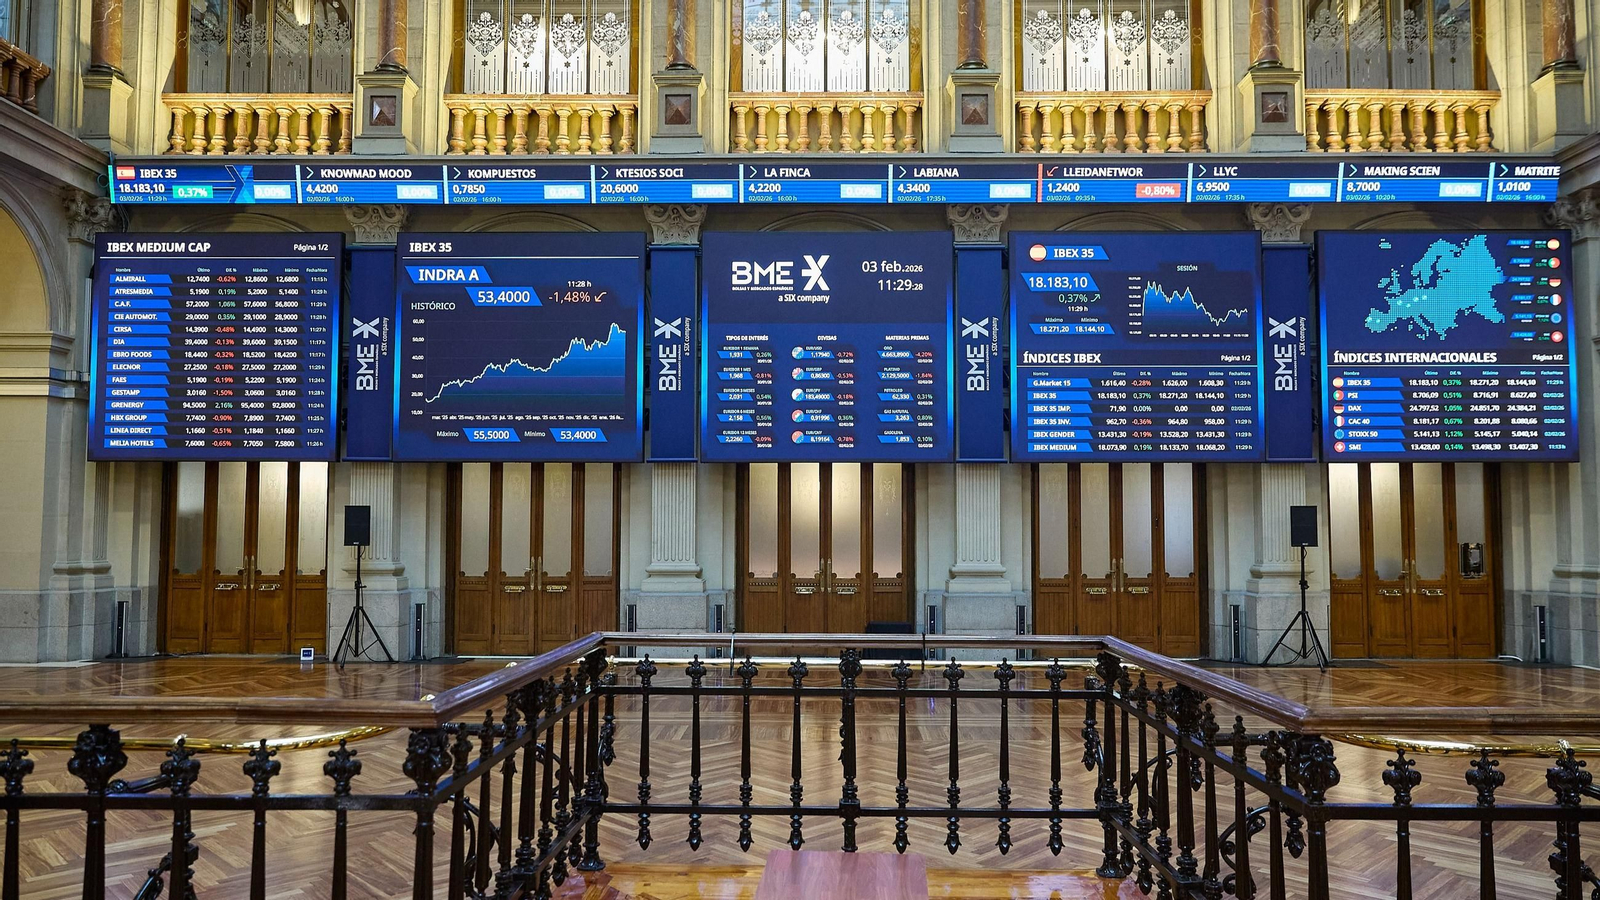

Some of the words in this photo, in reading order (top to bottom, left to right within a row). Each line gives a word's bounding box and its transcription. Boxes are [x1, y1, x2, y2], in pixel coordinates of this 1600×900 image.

[140, 169, 163, 178] IBEX
[165, 169, 177, 178] 35
[321, 169, 376, 178] KNOWMAD
[379, 169, 412, 178] MOOD
[468, 169, 536, 179] KOMPUESTOS
[616, 168, 657, 178] KTESIOS
[659, 168, 683, 178] SOCI
[764, 168, 778, 177] LA
[780, 168, 811, 177] FINCA
[914, 168, 959, 177] LABIANA
[1064, 167, 1143, 177] LLEIDANETWOR
[1214, 166, 1238, 176] LLYC
[1364, 166, 1408, 176] MAKING
[1409, 166, 1440, 176] SCIEN
[1515, 166, 1561, 176] MATRITE
[119, 183, 165, 194] 18.183,10
[306, 184, 338, 194] 4,4200
[453, 184, 485, 194] 0,7850
[600, 184, 639, 194] 20,6000
[748, 183, 781, 193] 4,2200
[897, 183, 930, 194] 4,3400
[1047, 183, 1080, 193] 1,2400
[1140, 186, 1176, 196] -0,80%
[1196, 182, 1230, 192] 6,9500
[1347, 182, 1381, 192] 8,7000
[1498, 182, 1531, 192] 1,0100
[178, 188, 208, 197] 0,37%
[107, 242, 134, 252] IBEX
[136, 242, 185, 252] MEDIUM
[188, 242, 211, 252] CAP
[294, 244, 316, 252] Página
[409, 242, 436, 252] IBEX
[438, 242, 452, 252] 35
[1054, 248, 1079, 258] IBEX
[1081, 248, 1094, 258] 35
[862, 261, 877, 272] 03
[419, 269, 466, 281] INDRA
[468, 269, 479, 281] A
[732, 261, 794, 285] BME
[878, 279, 923, 291] 11:29:28
[1029, 277, 1088, 289] 18.183,10
[478, 291, 530, 304] 53,4000
[549, 291, 590, 304] -1,48%
[784, 294, 796, 302] SIX
[797, 295, 830, 304] company
[1058, 294, 1088, 304] 0,37%
[411, 301, 456, 310] HISTÓRICO
[1023, 351, 1071, 363] ÍNDICES
[1074, 353, 1101, 363] IBEX
[1334, 351, 1382, 363] ÍNDICES
[1384, 352, 1497, 363] INTERNACIONALES
[1532, 354, 1553, 362] Página
[356, 344, 374, 390] BME
[659, 345, 677, 391] BME
[967, 345, 984, 391] BME
[1274, 344, 1293, 391] BME
[474, 430, 509, 440] 55,5000
[561, 431, 596, 440] 53,4000
